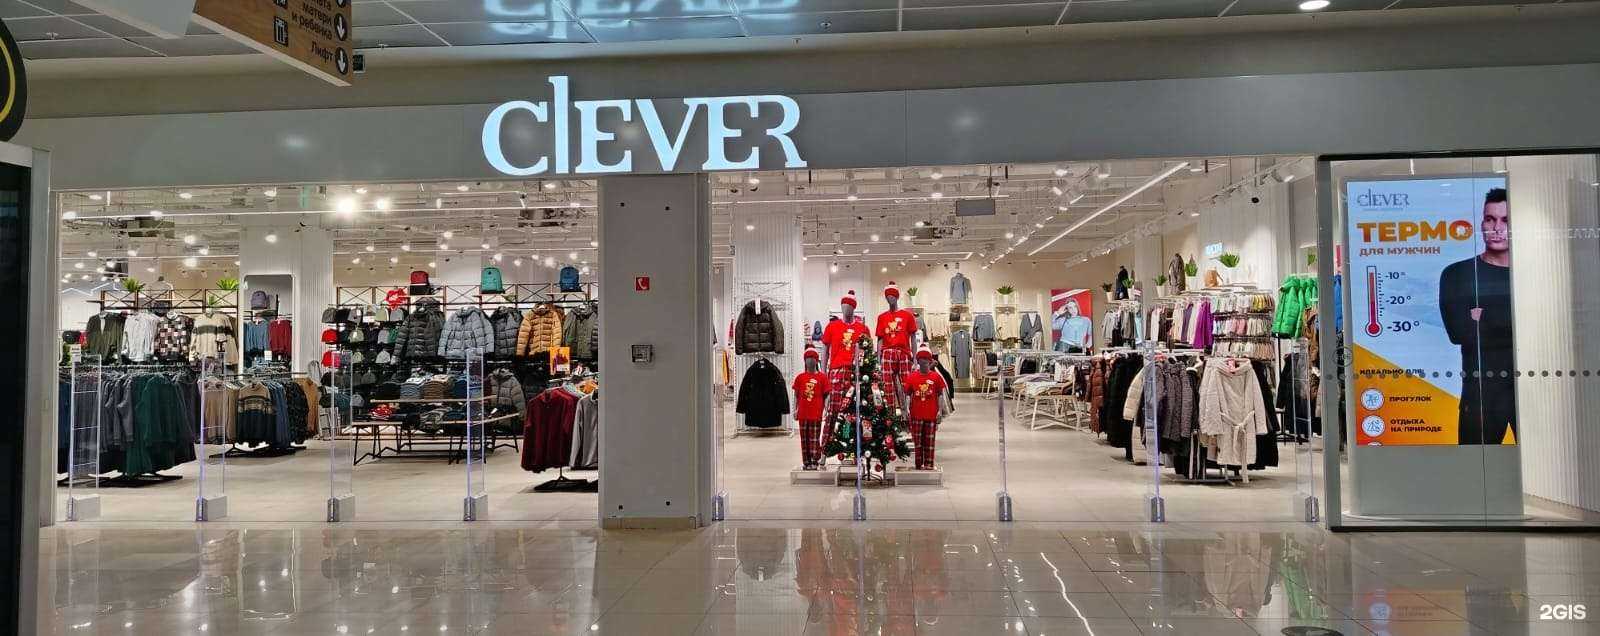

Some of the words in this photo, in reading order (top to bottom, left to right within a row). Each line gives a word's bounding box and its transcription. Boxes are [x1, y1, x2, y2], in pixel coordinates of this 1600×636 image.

[312, 41, 334, 63] Лифт
[1357, 220, 1474, 243] ТЕРМО
[1360, 248, 1384, 257] ДЛЯ
[1388, 246, 1441, 255] МУЖЧИН
[1386, 295, 1412, 305] -20°
[1387, 320, 1420, 332] -30°
[1359, 368, 1404, 376] ИДЕАЛЬНО
[1390, 418, 1425, 426] ОТДЫХА
